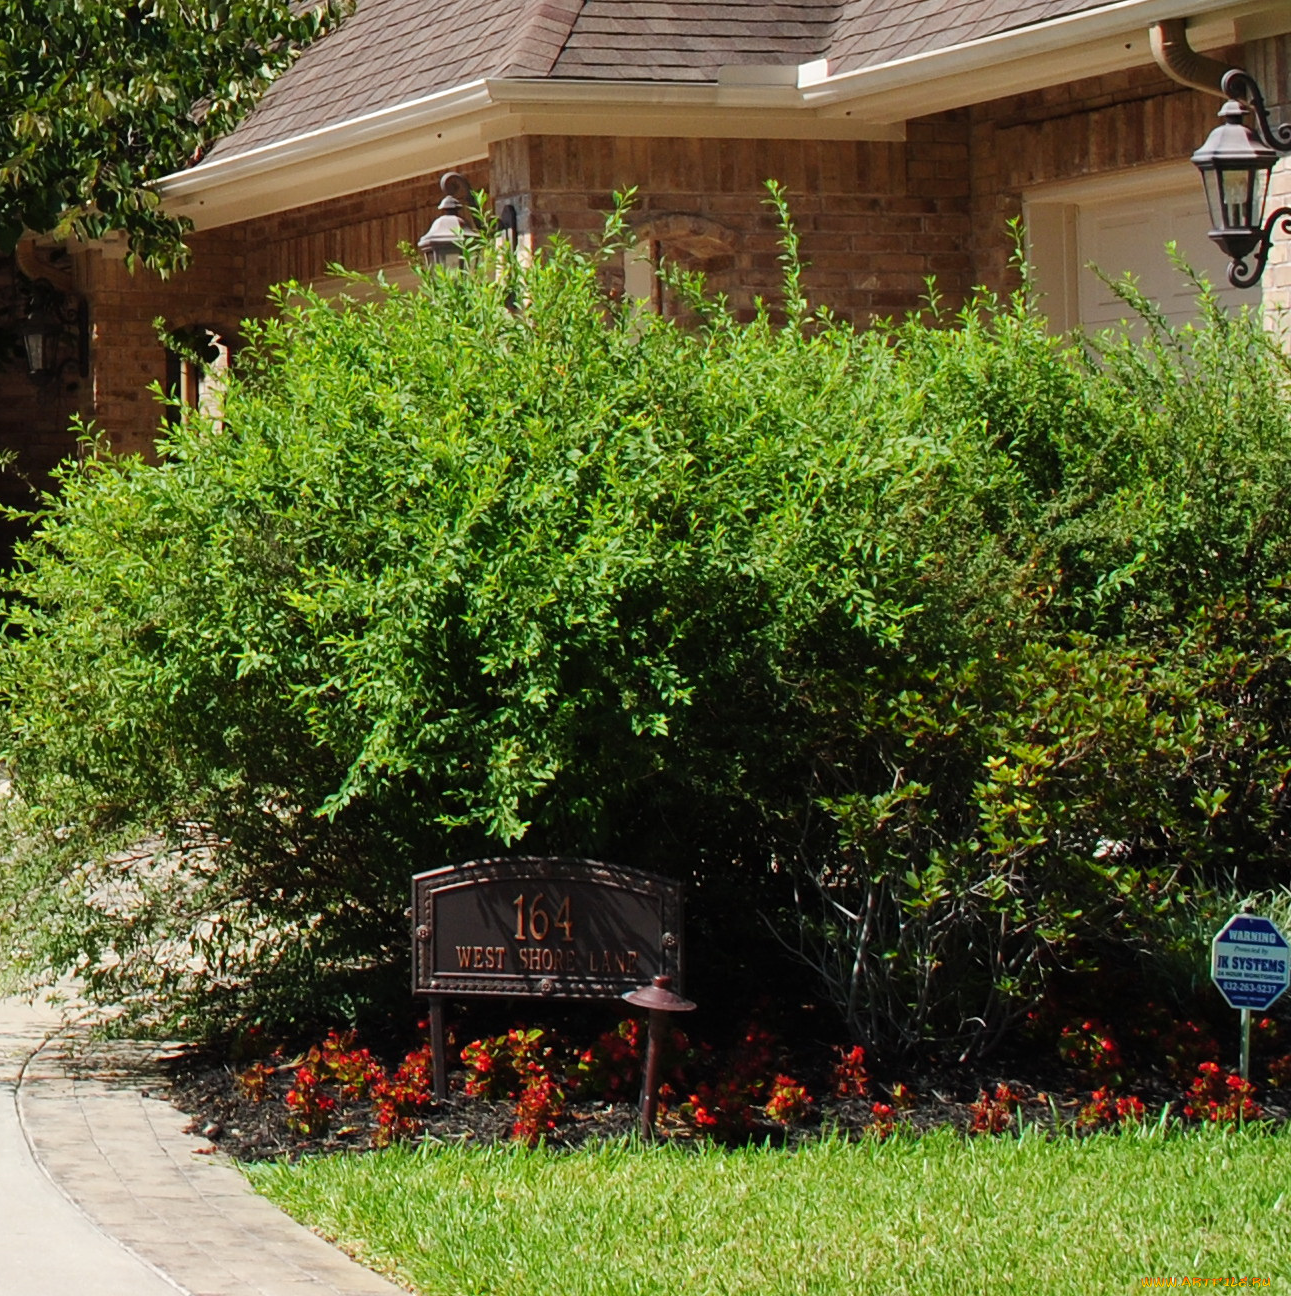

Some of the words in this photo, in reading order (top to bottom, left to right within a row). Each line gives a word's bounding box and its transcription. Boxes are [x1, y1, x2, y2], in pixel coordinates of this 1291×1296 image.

[513, 892, 575, 942] 164
[1229, 930, 1276, 944] WARNING
[455, 945, 506, 969] WEST
[518, 947, 576, 972] SHORE
[589, 950, 640, 974] LANE
[1232, 956, 1286, 973] SYSTEMS
